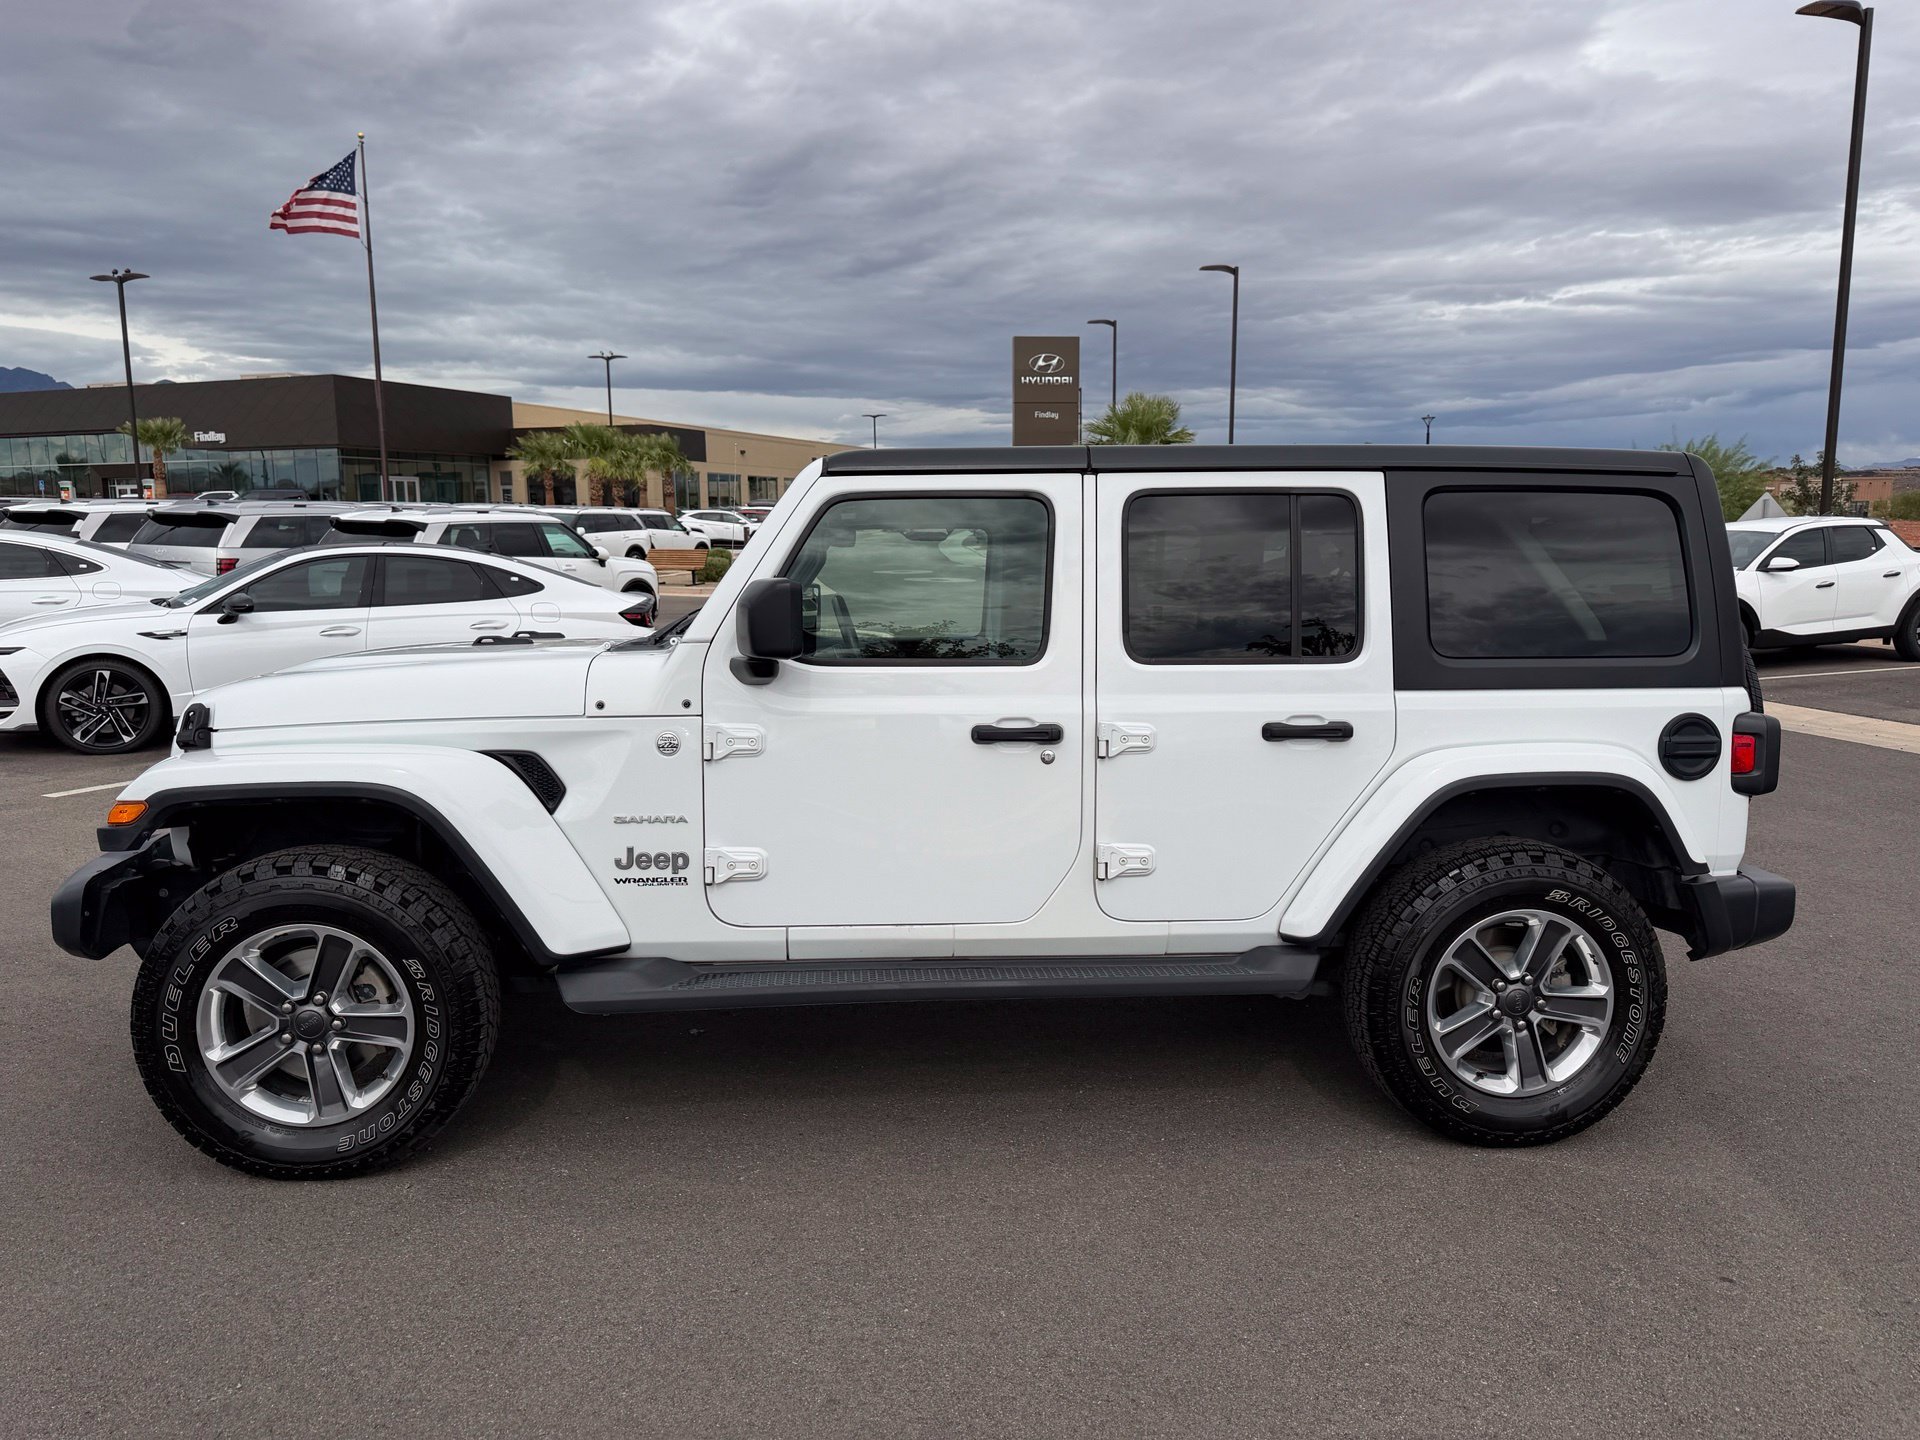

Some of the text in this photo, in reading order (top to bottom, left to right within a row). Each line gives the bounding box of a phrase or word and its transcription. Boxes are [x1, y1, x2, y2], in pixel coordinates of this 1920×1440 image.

[1021, 376, 1073, 385] HYUNDAI
[1034, 411, 1059, 420] Findlay
[194, 431, 226, 444] Findlay
[613, 815, 689, 824] SAHARA
[614, 846, 690, 874] Jeep
[1544, 889, 1649, 1065] BRIDGESTONE
[161, 916, 239, 1074] DUELER
[338, 958, 440, 1153] BRIDGESTONE
[1405, 975, 1480, 1115] DUELER
